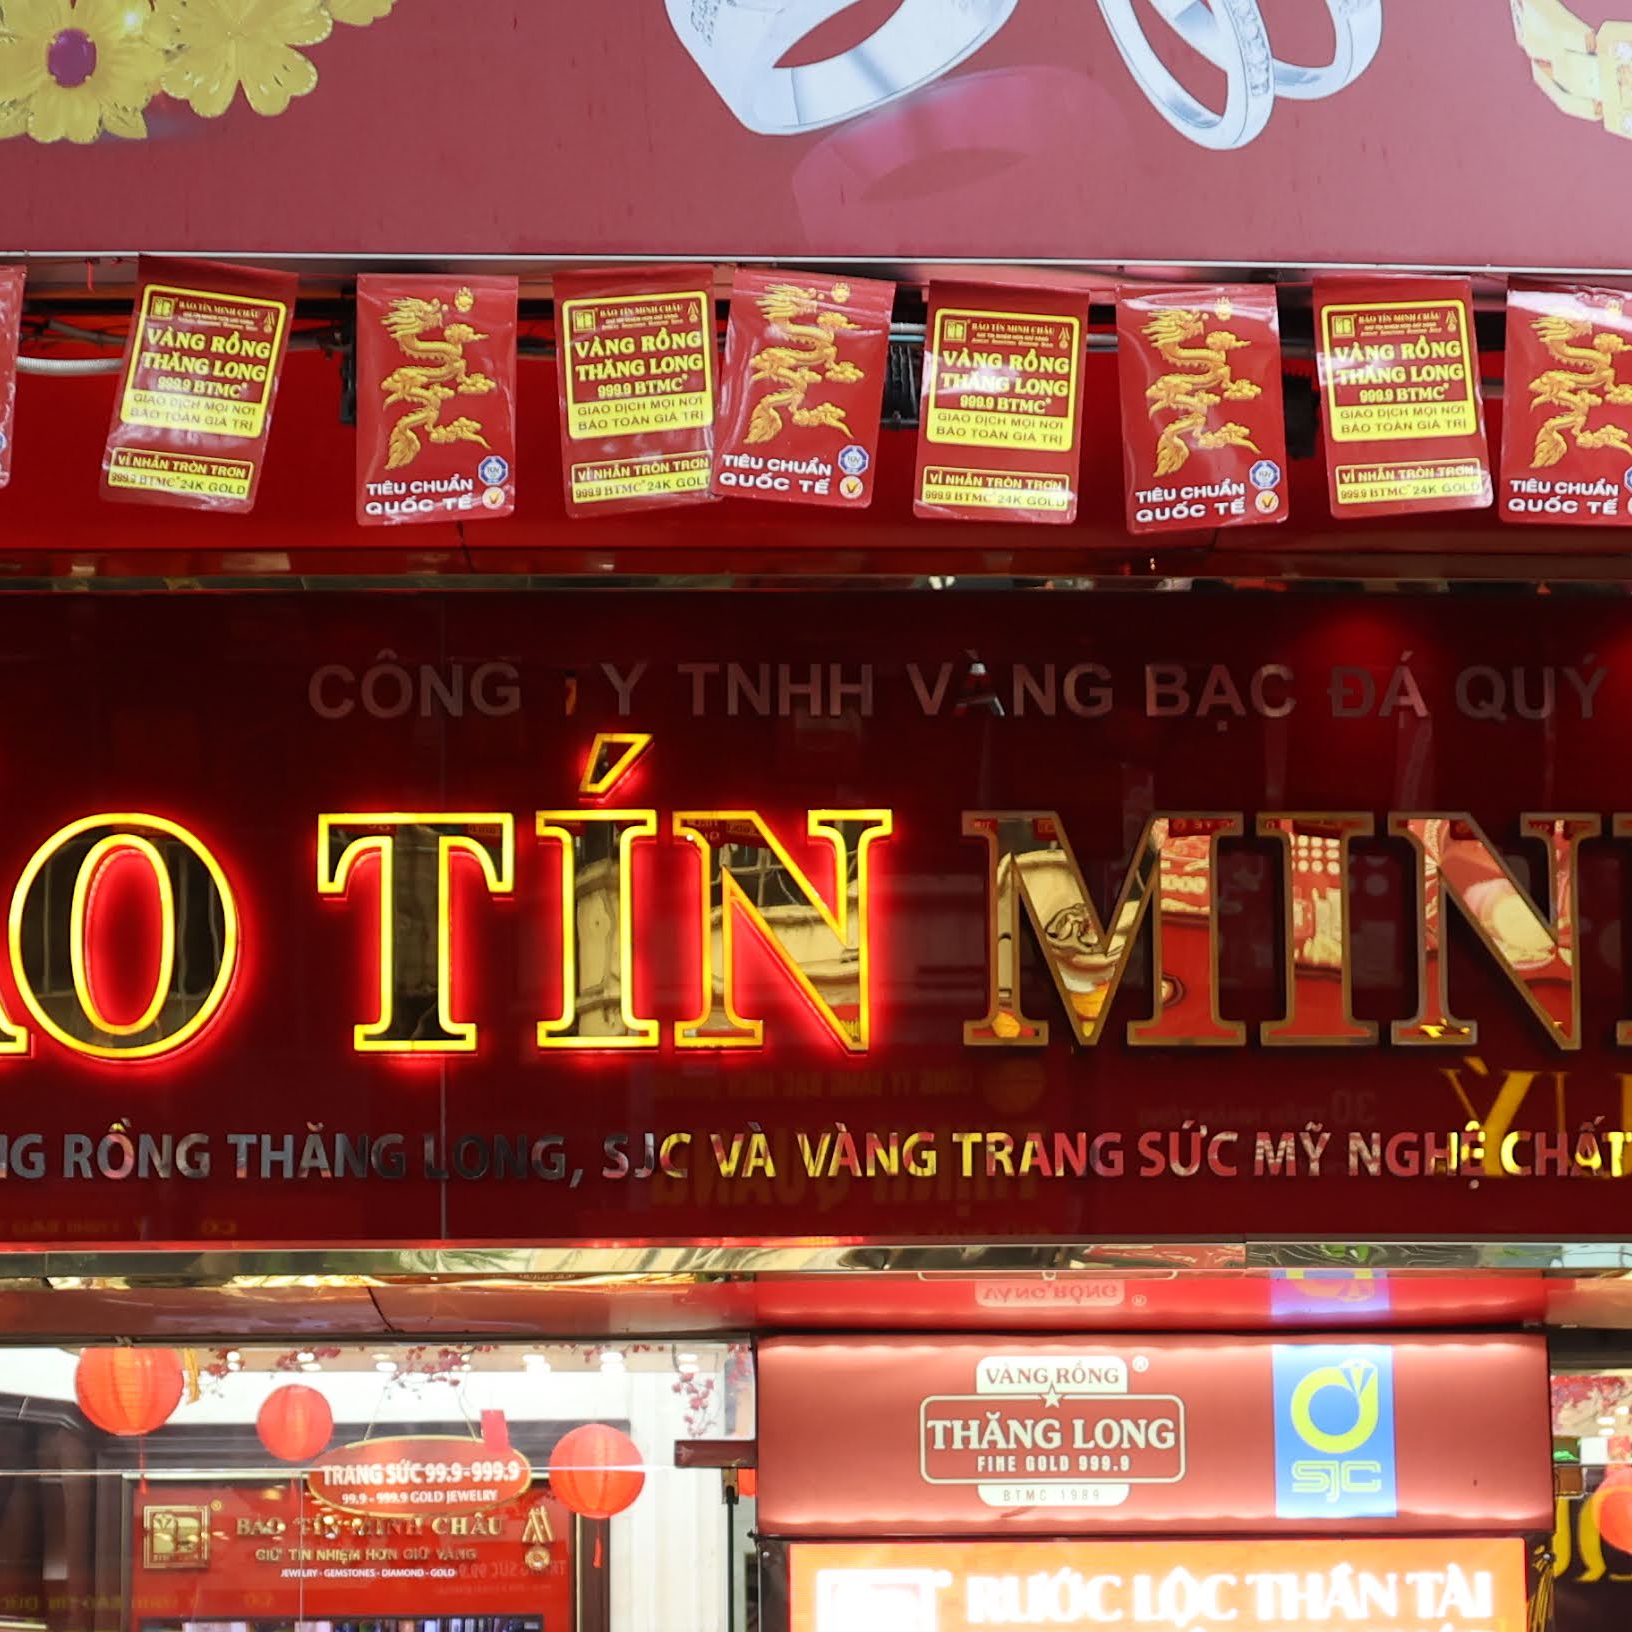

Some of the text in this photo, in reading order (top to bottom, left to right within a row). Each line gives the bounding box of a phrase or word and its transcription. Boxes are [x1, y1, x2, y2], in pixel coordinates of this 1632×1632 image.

[309, 651, 520, 717] CÔNG
[678, 662, 872, 717] TNHH
[317, 734, 894, 1051] TÍN
[64, 1117, 211, 1180] RỒNG
[228, 1118, 404, 1180] THĂNG
[603, 1132, 692, 1180] SJC
[709, 1122, 777, 1178] VÀ
[796, 1122, 936, 1178] VÀNG
[953, 1132, 1124, 1179] TRANG
[1139, 1119, 1239, 1178] SỨC
[1254, 1120, 1332, 1177] MỸ
[985, 1359, 1120, 1385] VÀNG RỒNG
[926, 1411, 1176, 1450] THĂNG LONG
[322, 1464, 383, 1487] TRANG
[386, 1458, 421, 1485] SỨC
[976, 1455, 1131, 1473] FINE GOLD 999.9
[410, 1489, 498, 1503] GOLD JEWELRY
[381, 1568, 424, 1577] DIAMOND
[430, 1568, 456, 1577] GOLD
[1405, 1563, 1491, 1621] TÀI
